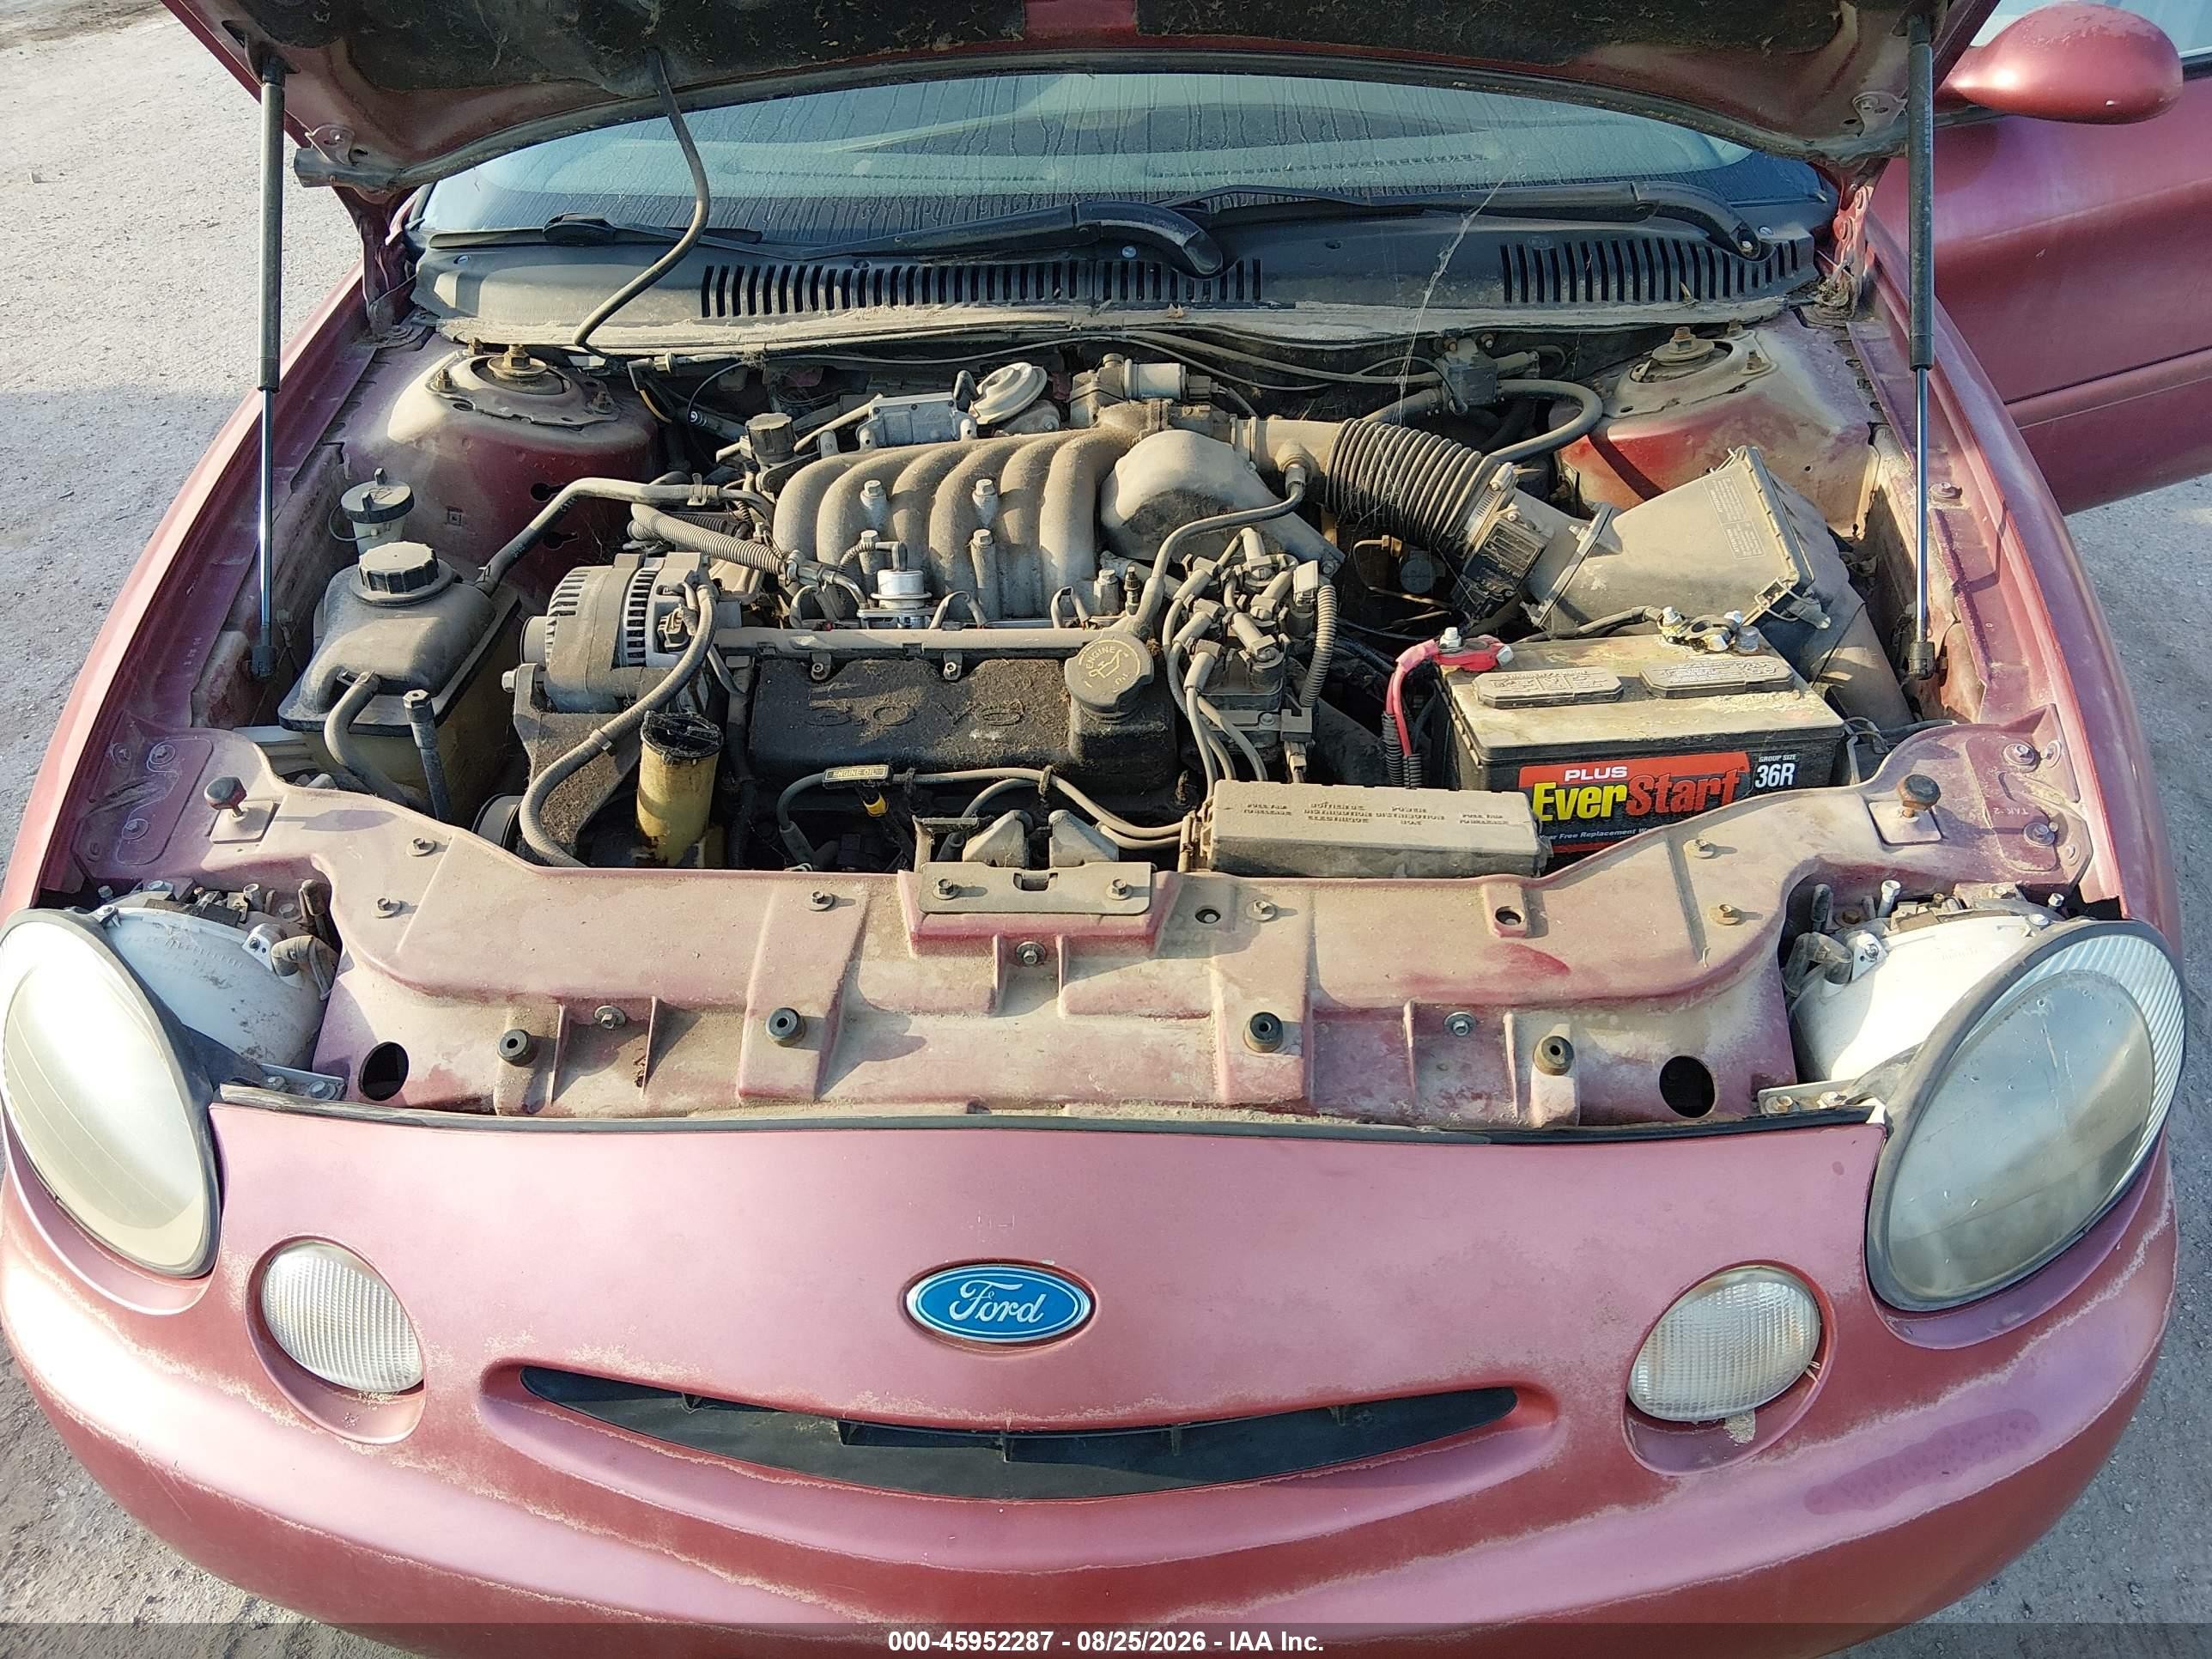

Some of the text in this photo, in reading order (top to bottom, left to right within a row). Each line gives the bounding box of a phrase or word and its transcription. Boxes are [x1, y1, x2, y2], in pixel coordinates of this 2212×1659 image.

[1085, 646, 1116, 669] ENGINE
[832, 768, 877, 778] ENGINE OIL
[1565, 766, 1627, 781] PLUS
[1754, 763, 1796, 788] 36R
[1532, 768, 1740, 822] EverStart
[1580, 828, 1637, 838] Replacement
[949, 1279, 1047, 1323] Ford
